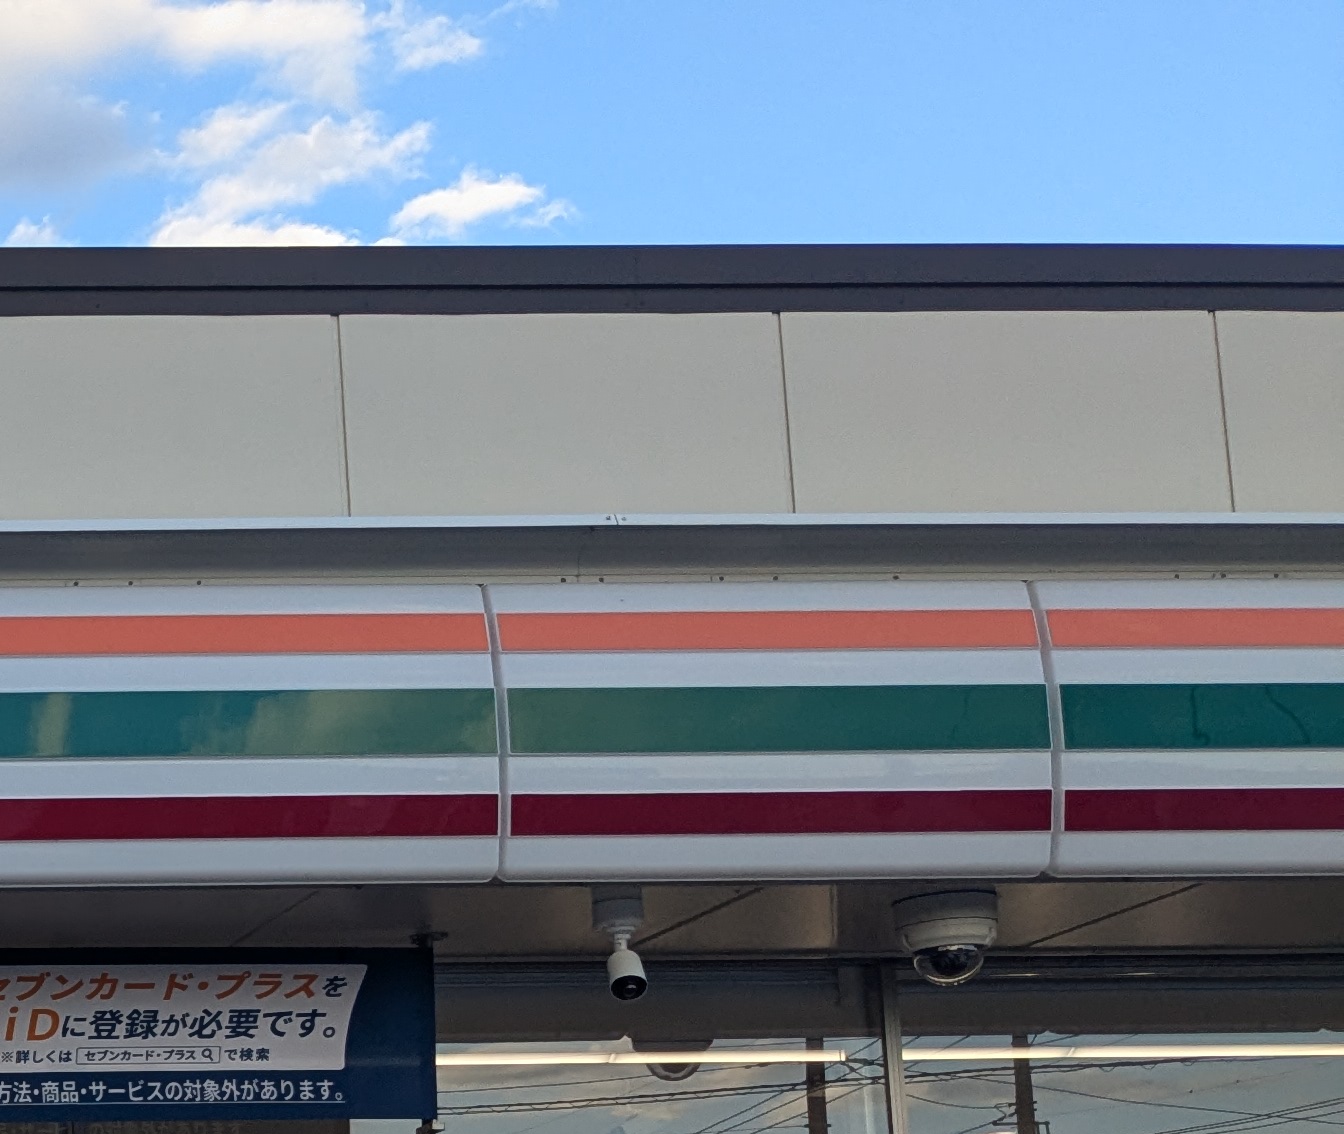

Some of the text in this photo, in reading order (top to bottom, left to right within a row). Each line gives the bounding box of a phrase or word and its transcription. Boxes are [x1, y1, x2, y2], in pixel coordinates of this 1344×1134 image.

[83, 1048, 197, 1063] セブンカード・プラス
[224, 1048, 270, 1063] で検索
